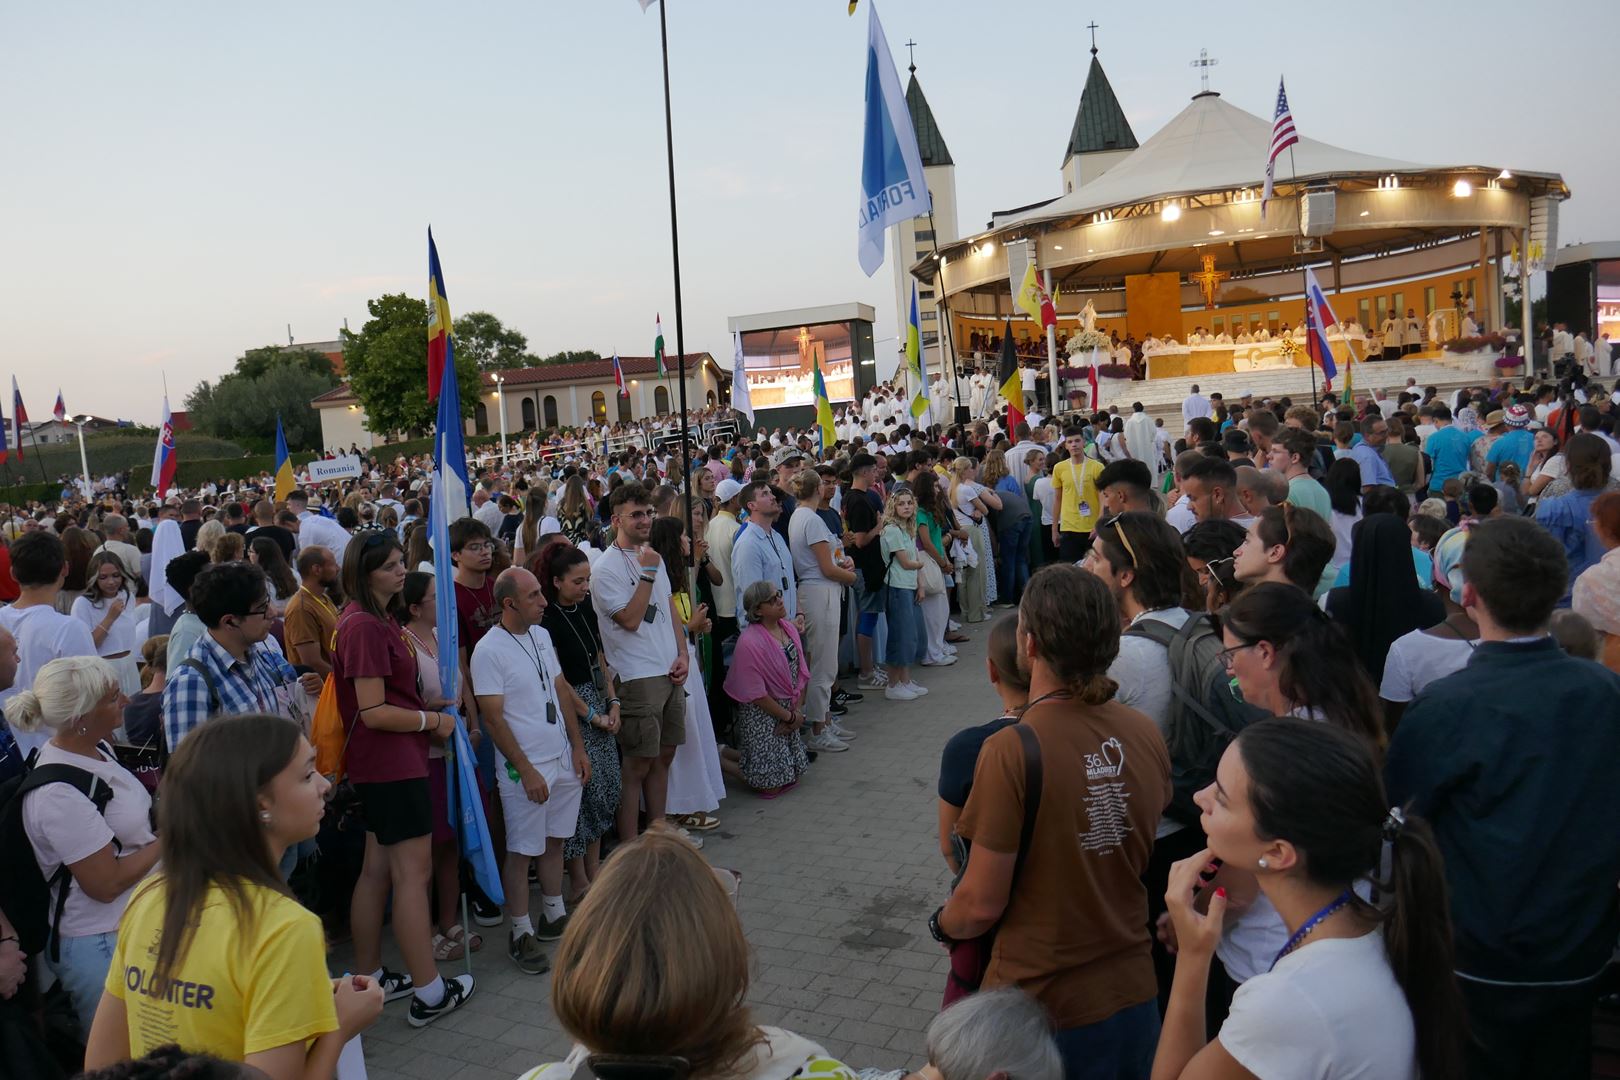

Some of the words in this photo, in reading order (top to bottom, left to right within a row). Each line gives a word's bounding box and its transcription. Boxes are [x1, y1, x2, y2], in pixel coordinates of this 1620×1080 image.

[316, 464, 355, 475] Romania
[1083, 753, 1105, 769] 36.
[124, 966, 214, 1010] OLONTER
